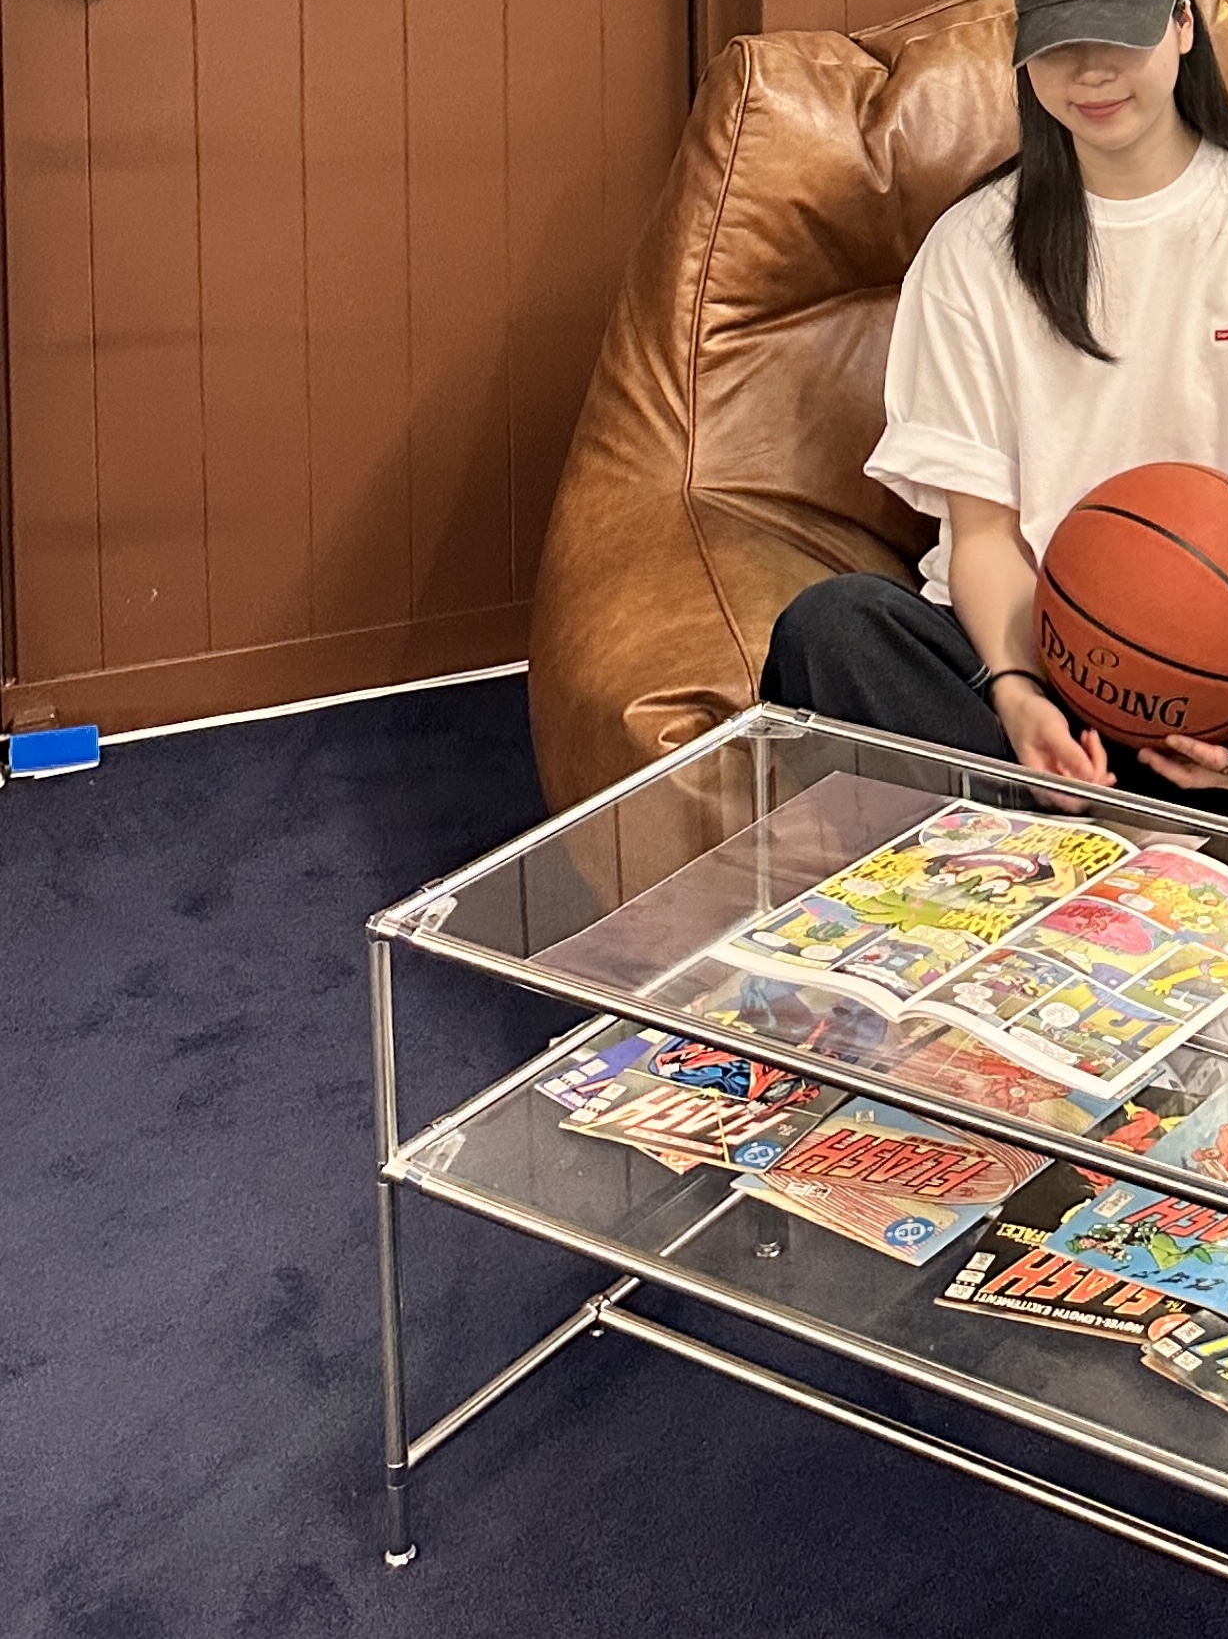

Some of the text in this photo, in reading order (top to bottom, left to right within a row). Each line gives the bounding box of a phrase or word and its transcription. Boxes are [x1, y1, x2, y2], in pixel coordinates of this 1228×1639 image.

[1041, 609, 1190, 729] SPALDING
[592, 1085, 793, 1145] FLASH
[748, 1147, 769, 1161] DC
[779, 1128, 996, 1197] FLASH
[899, 1225, 921, 1237] DC
[978, 1247, 1166, 1317] FLASH
[1163, 1298, 1187, 1314] The
[973, 1291, 1145, 1334] NOVEL-LENGTH EXCITEMENT!
